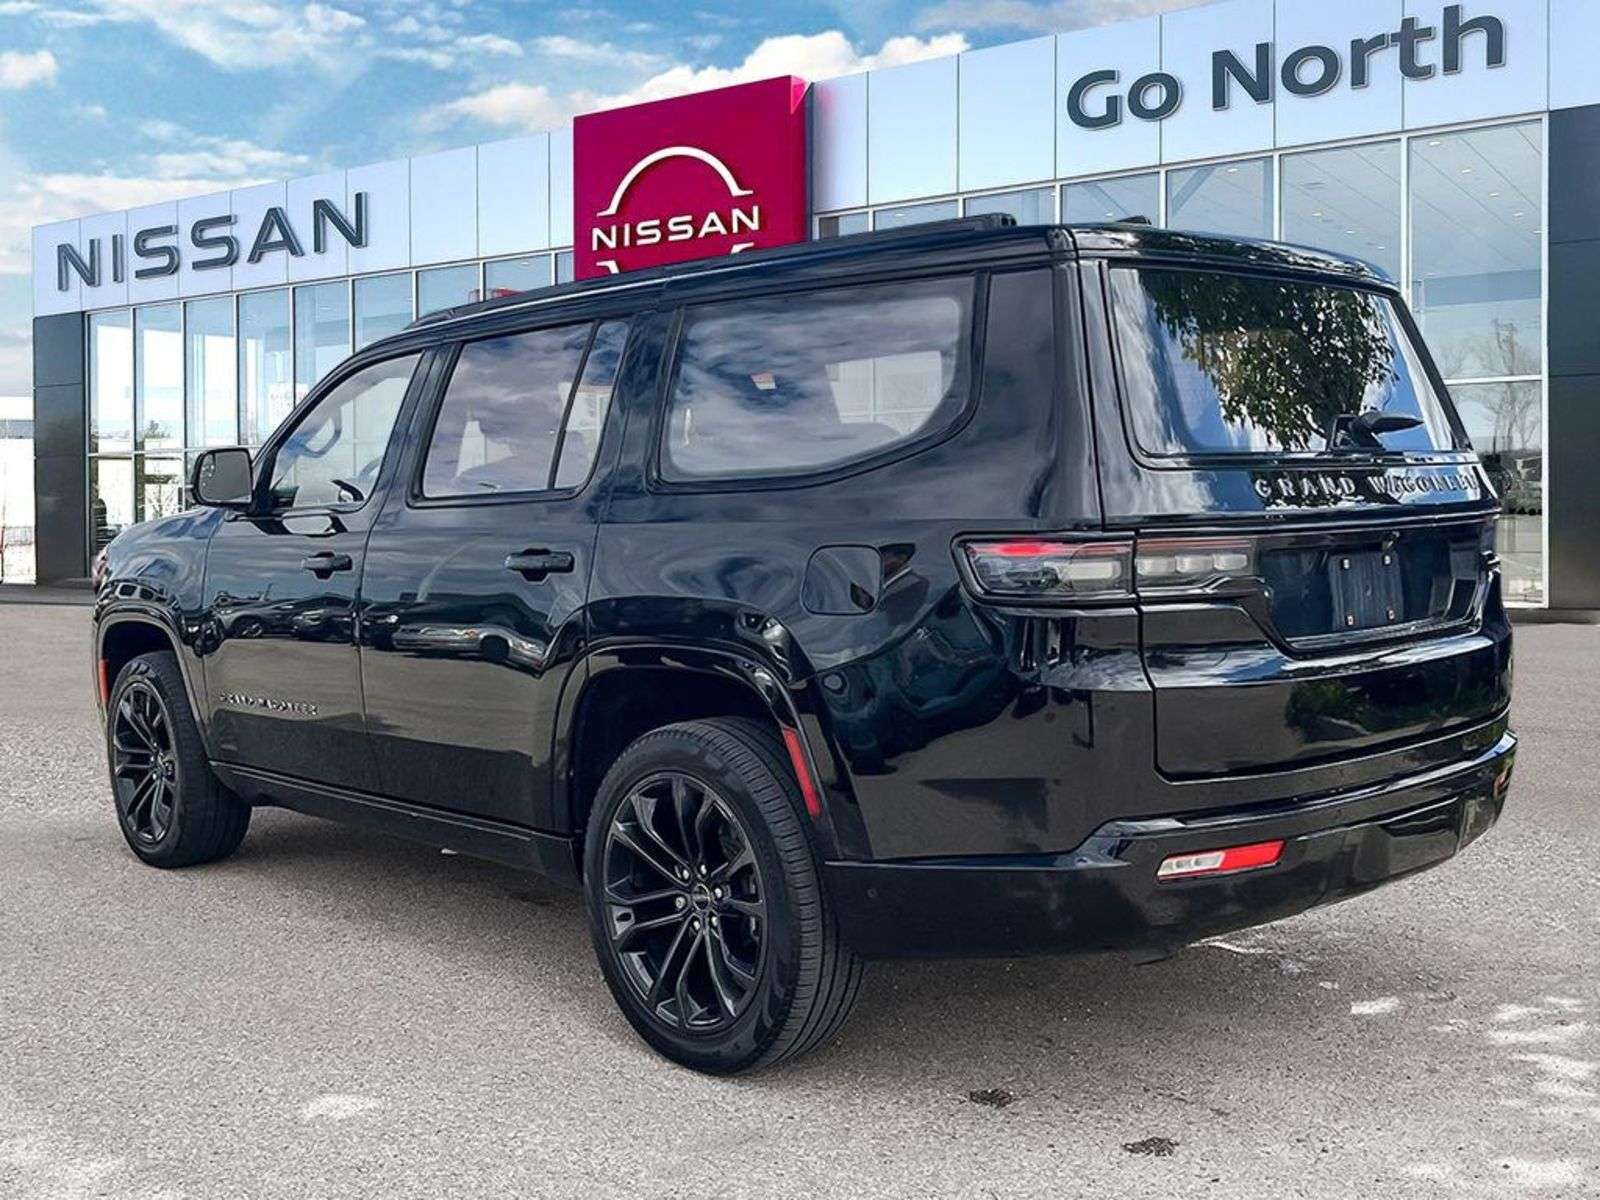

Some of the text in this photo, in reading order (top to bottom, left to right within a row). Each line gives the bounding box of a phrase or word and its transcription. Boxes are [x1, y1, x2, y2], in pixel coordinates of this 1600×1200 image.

[1066, 4, 1507, 130] Go North
[57, 191, 369, 292] NISSAN
[591, 205, 760, 251] NISSAN
[1254, 475, 1356, 498] GRAND
